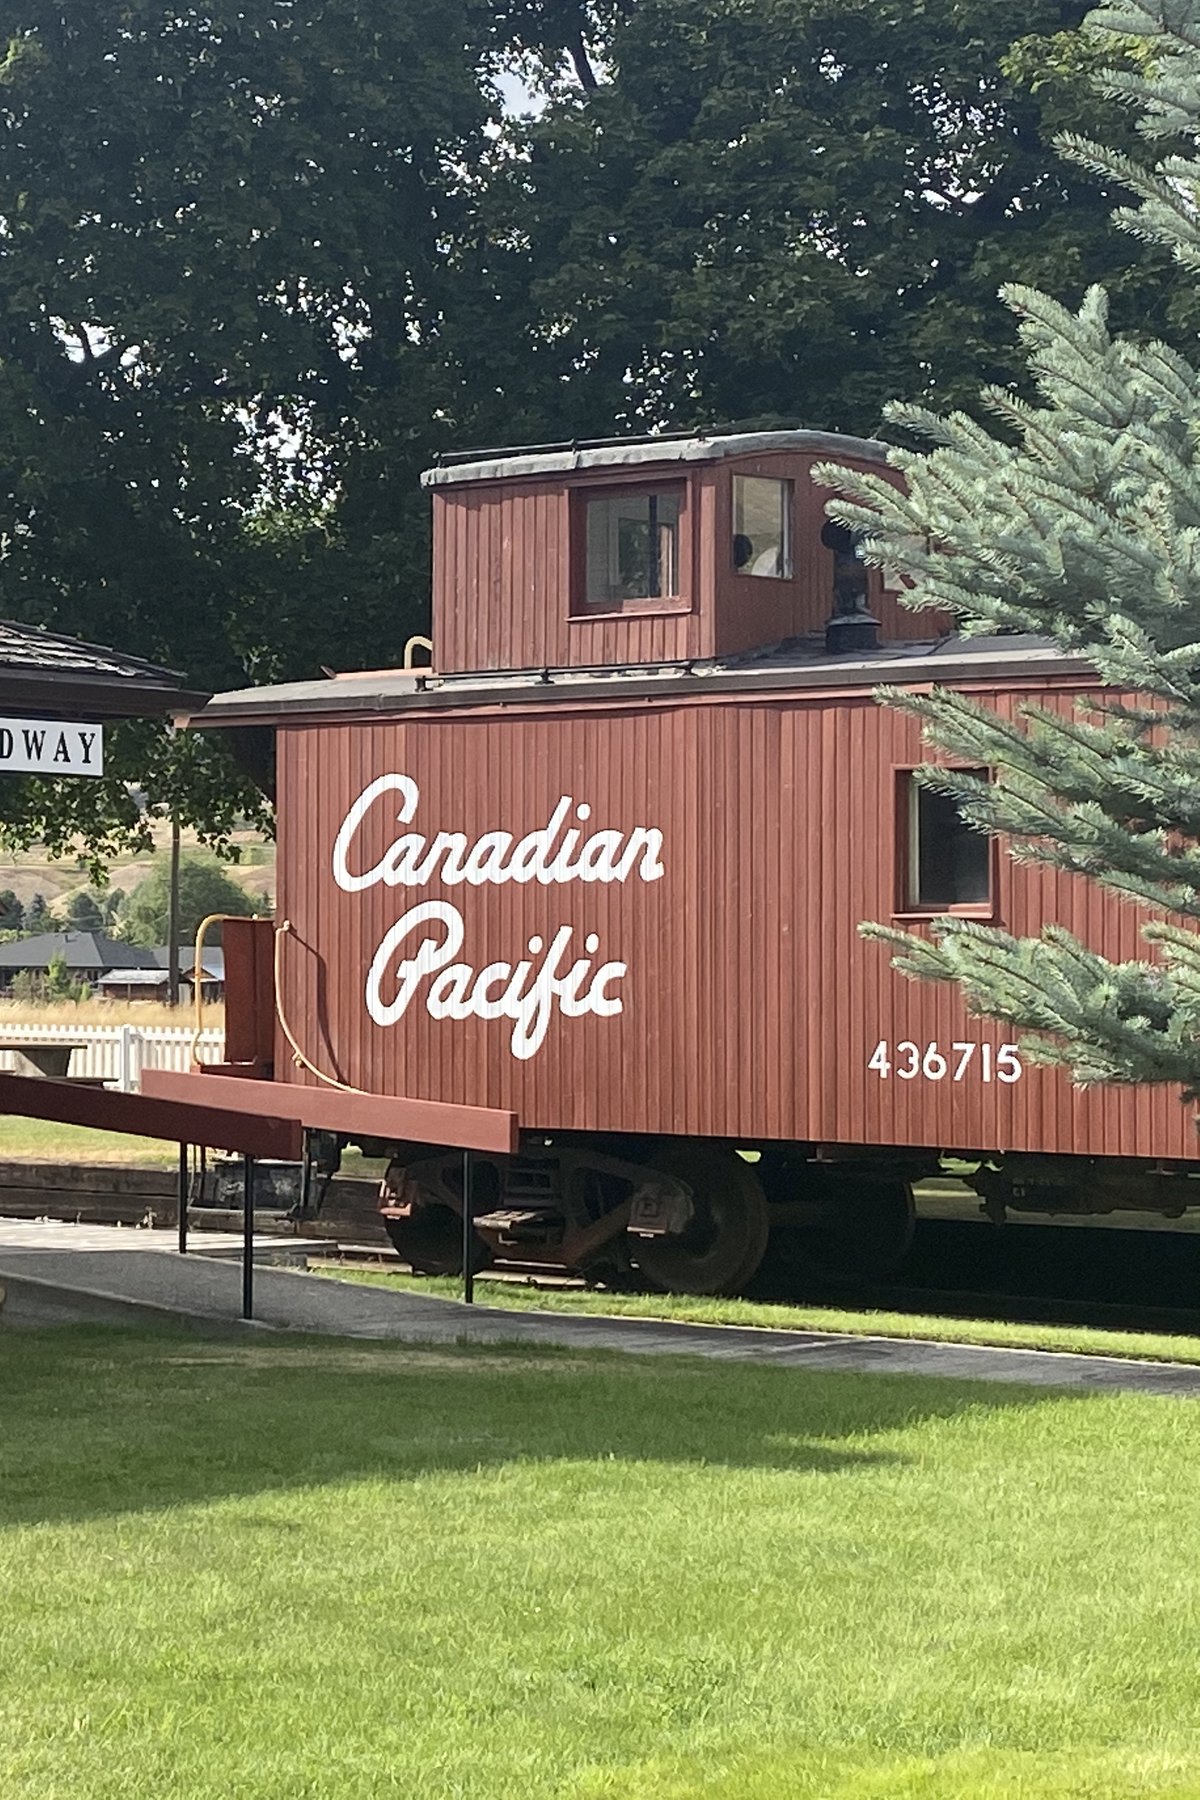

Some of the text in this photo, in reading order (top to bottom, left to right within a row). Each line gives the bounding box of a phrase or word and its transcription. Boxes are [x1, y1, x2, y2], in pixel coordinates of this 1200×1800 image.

[332, 773, 665, 893] Canadian
[365, 900, 628, 1060] Pacific
[867, 1040, 1022, 1083] 436715
